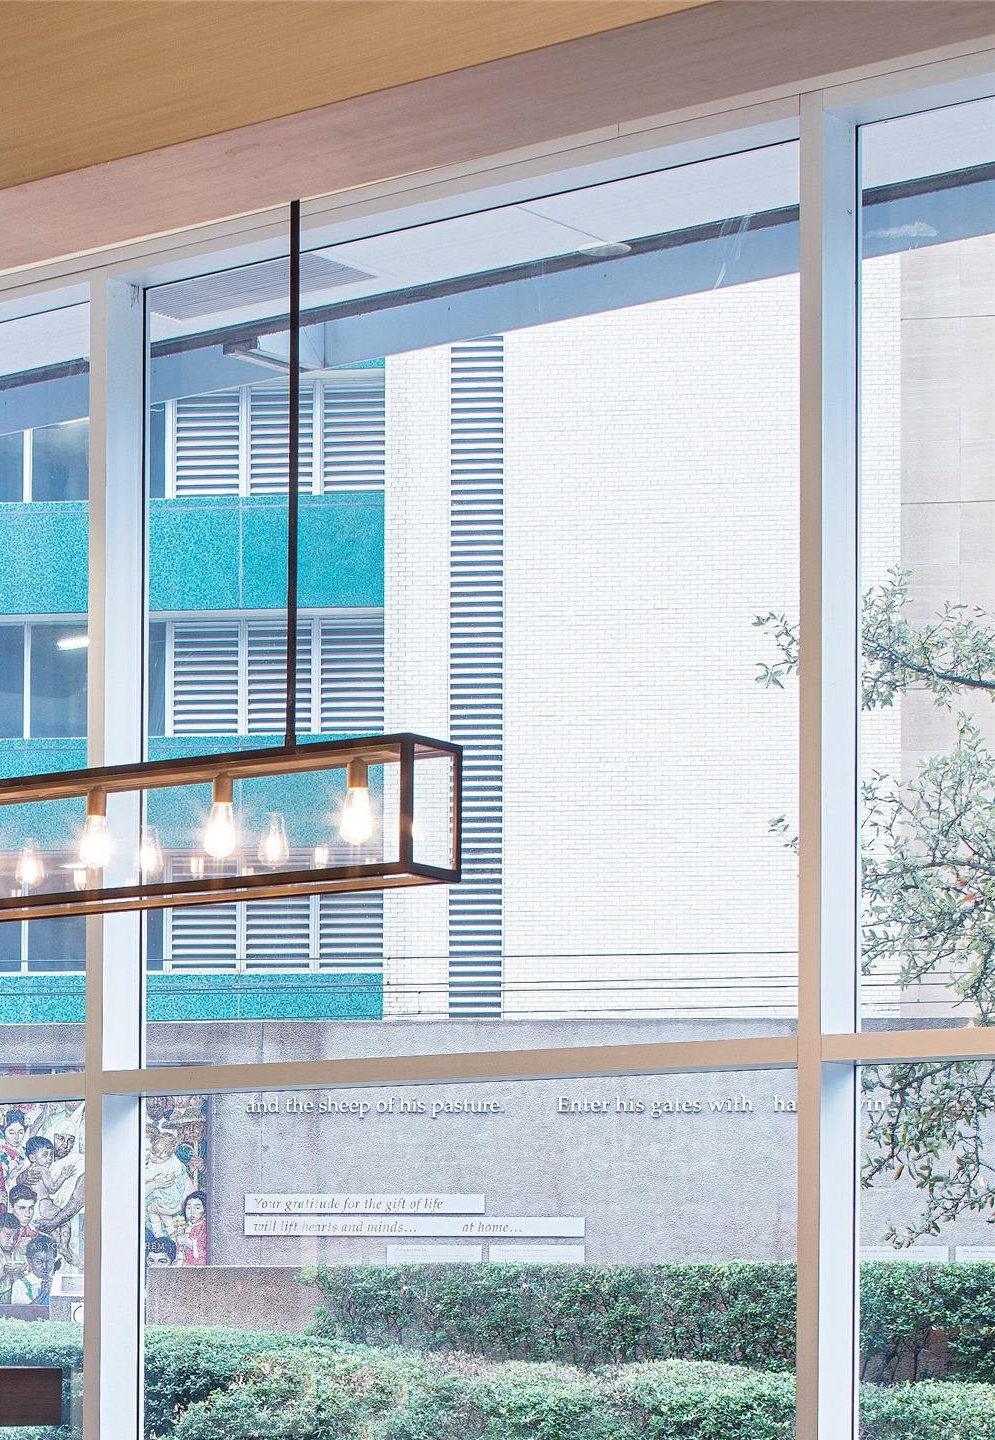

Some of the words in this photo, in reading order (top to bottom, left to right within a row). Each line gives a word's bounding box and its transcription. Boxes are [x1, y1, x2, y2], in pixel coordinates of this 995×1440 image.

[245, 1096, 279, 1113] and
[285, 1097, 313, 1113] the
[318, 1096, 371, 1119] sheep
[376, 1096, 395, 1113] of
[399, 1096, 426, 1113] his
[431, 1098, 505, 1119] pasture.
[557, 1096, 610, 1113] Enter
[615, 1096, 645, 1113] his
[650, 1097, 702, 1118] gates
[708, 1095, 753, 1112] with
[254, 1198, 282, 1209] Your
[285, 1198, 340, 1212] gratitude
[342, 1198, 361, 1212] for
[364, 1198, 382, 1209] the
[385, 1198, 406, 1212] gift
[409, 1198, 423, 1212] of
[424, 1198, 444, 1212] life
[254, 1220, 277, 1232] will
[280, 1220, 299, 1234] lift
[302, 1220, 338, 1232] hearts
[341, 1220, 364, 1232] and
[462, 1221, 475, 1232] at
